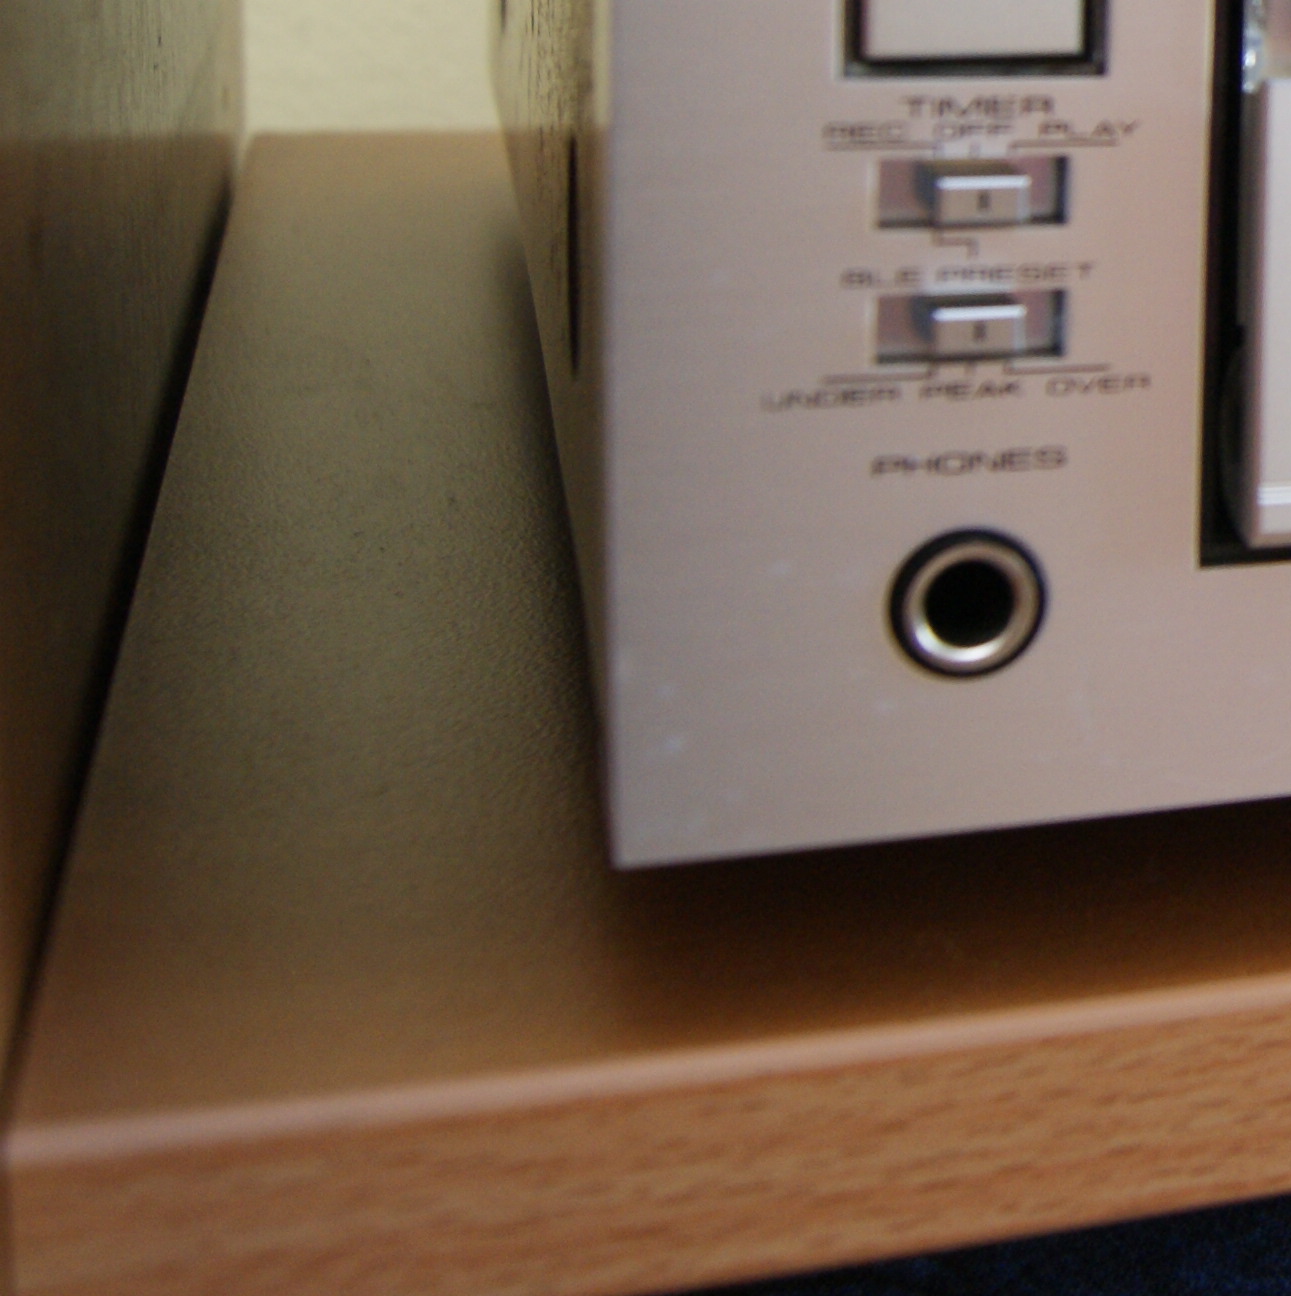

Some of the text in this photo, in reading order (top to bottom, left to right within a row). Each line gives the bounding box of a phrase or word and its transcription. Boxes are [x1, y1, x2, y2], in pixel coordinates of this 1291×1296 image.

[903, 94, 1054, 117] TIMER
[935, 260, 1095, 284] PRESET
[759, 373, 1151, 412] UNDER PEAK OVER
[870, 444, 1069, 477] PHONES
